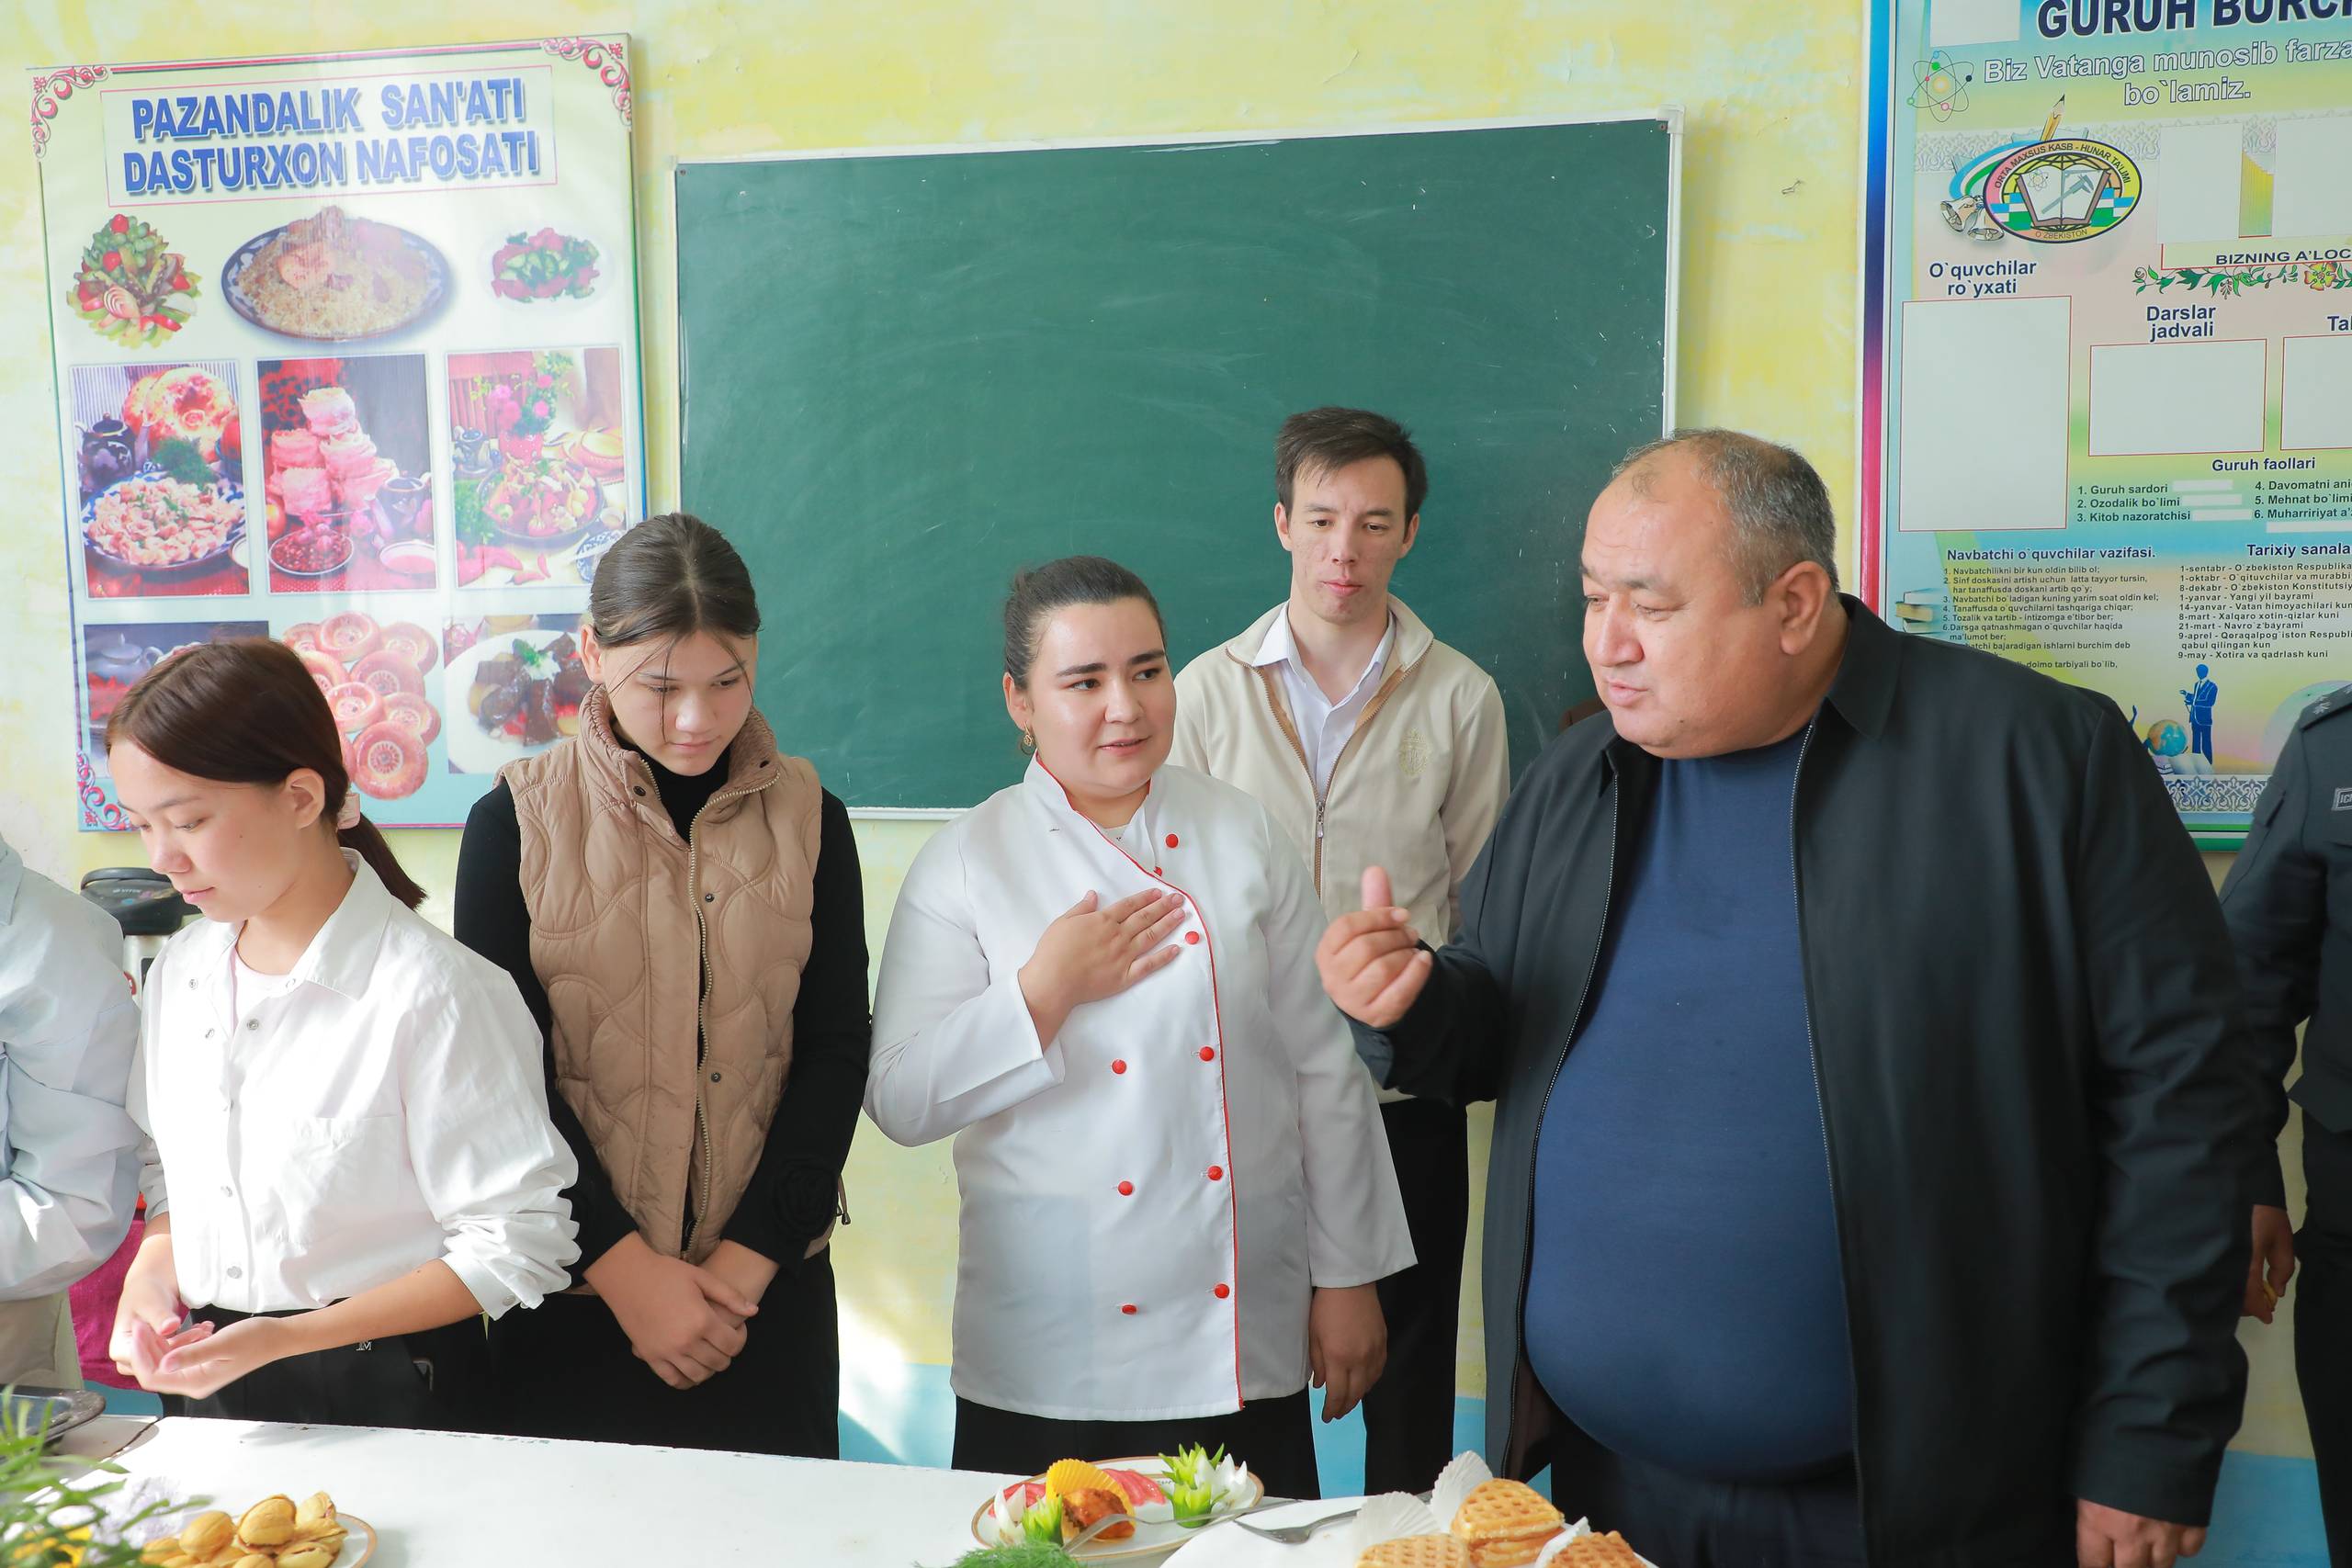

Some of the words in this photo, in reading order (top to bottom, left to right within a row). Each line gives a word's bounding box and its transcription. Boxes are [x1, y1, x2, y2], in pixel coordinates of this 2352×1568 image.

[2037, 0, 2195, 39] GURUH
[1984, 58, 2027, 83] Biz
[2035, 53, 2145, 79] Vatanga
[2153, 40, 2278, 72] munosib
[131, 86, 361, 141] PAZANDALIK
[381, 78, 526, 129] SAN'ATI
[123, 141, 345, 194] DASTURXON
[356, 130, 539, 182] NAFOSATI
[1995, 164, 2011, 188] ORTA
[2012, 147, 2045, 168] MAXSUS
[2081, 144, 2110, 160] HUNAR
[2216, 252, 2290, 265] BIZNING
[2147, 305, 2216, 321] Darslar
[2150, 322, 2213, 343] jadvali
[2212, 458, 2258, 471] Guruh
[2264, 457, 2315, 469] faollari
[2078, 486, 2086, 494] 1.
[2091, 485, 2124, 494] Guruh
[2129, 484, 2167, 493] sardori
[2256, 481, 2264, 491] 4.
[2269, 479, 2329, 490] Davomatni
[2334, 479, 2352, 489] ani
[2077, 500, 2086, 508] 2.
[2090, 498, 2138, 507] Ozodalik
[2256, 496, 2264, 504] 5.
[2268, 494, 2310, 504] Mehnat
[2077, 513, 2086, 522] 3.
[2090, 513, 2119, 522] Kitob
[2123, 511, 2190, 521] nazoratchisi
[2255, 510, 2264, 518] 6.
[2267, 509, 2337, 519] Muharririyat
[1948, 549, 2013, 559] Navbatchi
[2100, 547, 2155, 558] vazifasi.
[2247, 544, 2296, 558] Tarixiy
[2301, 543, 2350, 555] sanala
[2297, 563, 2352, 571] Respublika
[2042, 594, 2070, 603] kuning
[2074, 594, 2097, 603] yarim
[2230, 593, 2256, 602] Yangi
[2260, 593, 2271, 602] yil
[2275, 592, 2313, 601] bayrami
[2180, 604, 2226, 612] 14-yanvar
[2266, 602, 2332, 611] himoyachilari
[2024, 614, 2064, 622] intizomga
[2259, 612, 2315, 620] xotin-qizlar
[2178, 632, 2211, 640] 9-aprel
[2211, 641, 2249, 649] qilingan
[2178, 651, 2206, 660] 9-may
[2262, 650, 2303, 660] qadrlash
